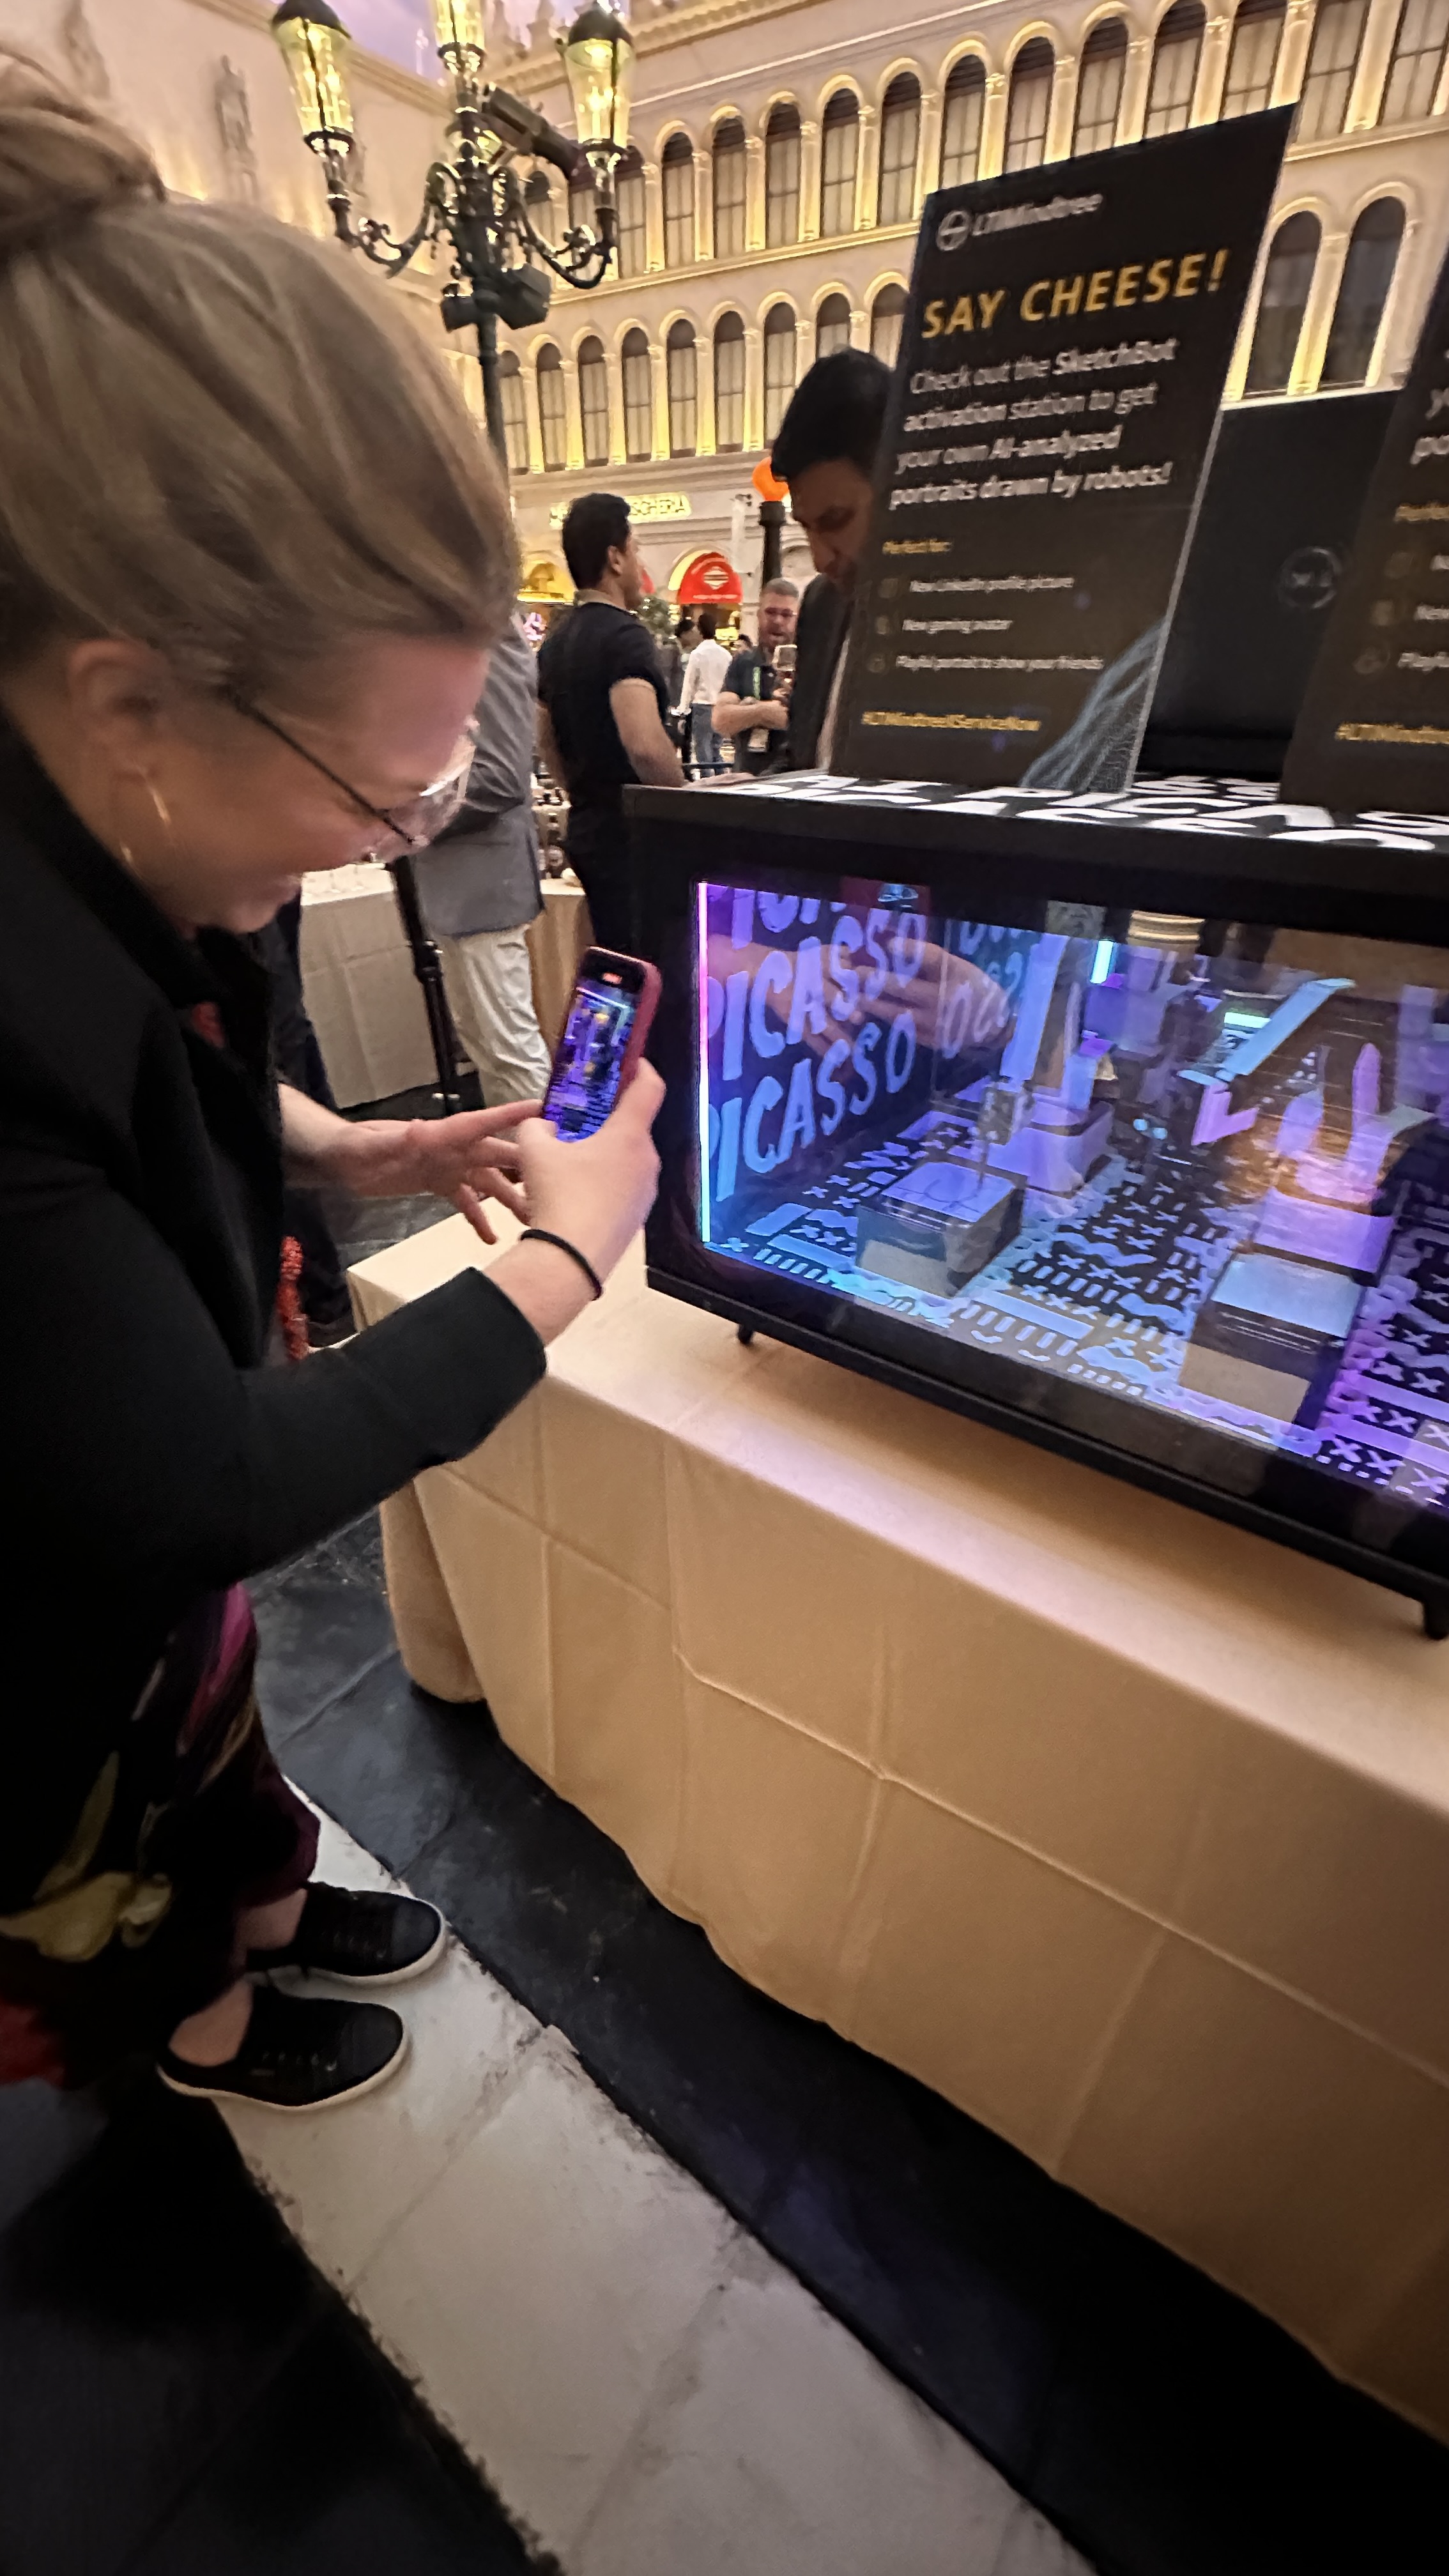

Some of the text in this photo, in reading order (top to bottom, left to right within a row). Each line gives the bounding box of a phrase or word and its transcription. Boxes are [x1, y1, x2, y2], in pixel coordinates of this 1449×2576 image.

[921, 249, 1229, 339] SAY CHEESE!
[910, 338, 1180, 394] Check out the SketchBot
[903, 381, 1158, 431] activation station to get
[894, 449, 943, 475] your
[943, 445, 989, 465] own
[889, 461, 1174, 510] portraits drawn by robots!
